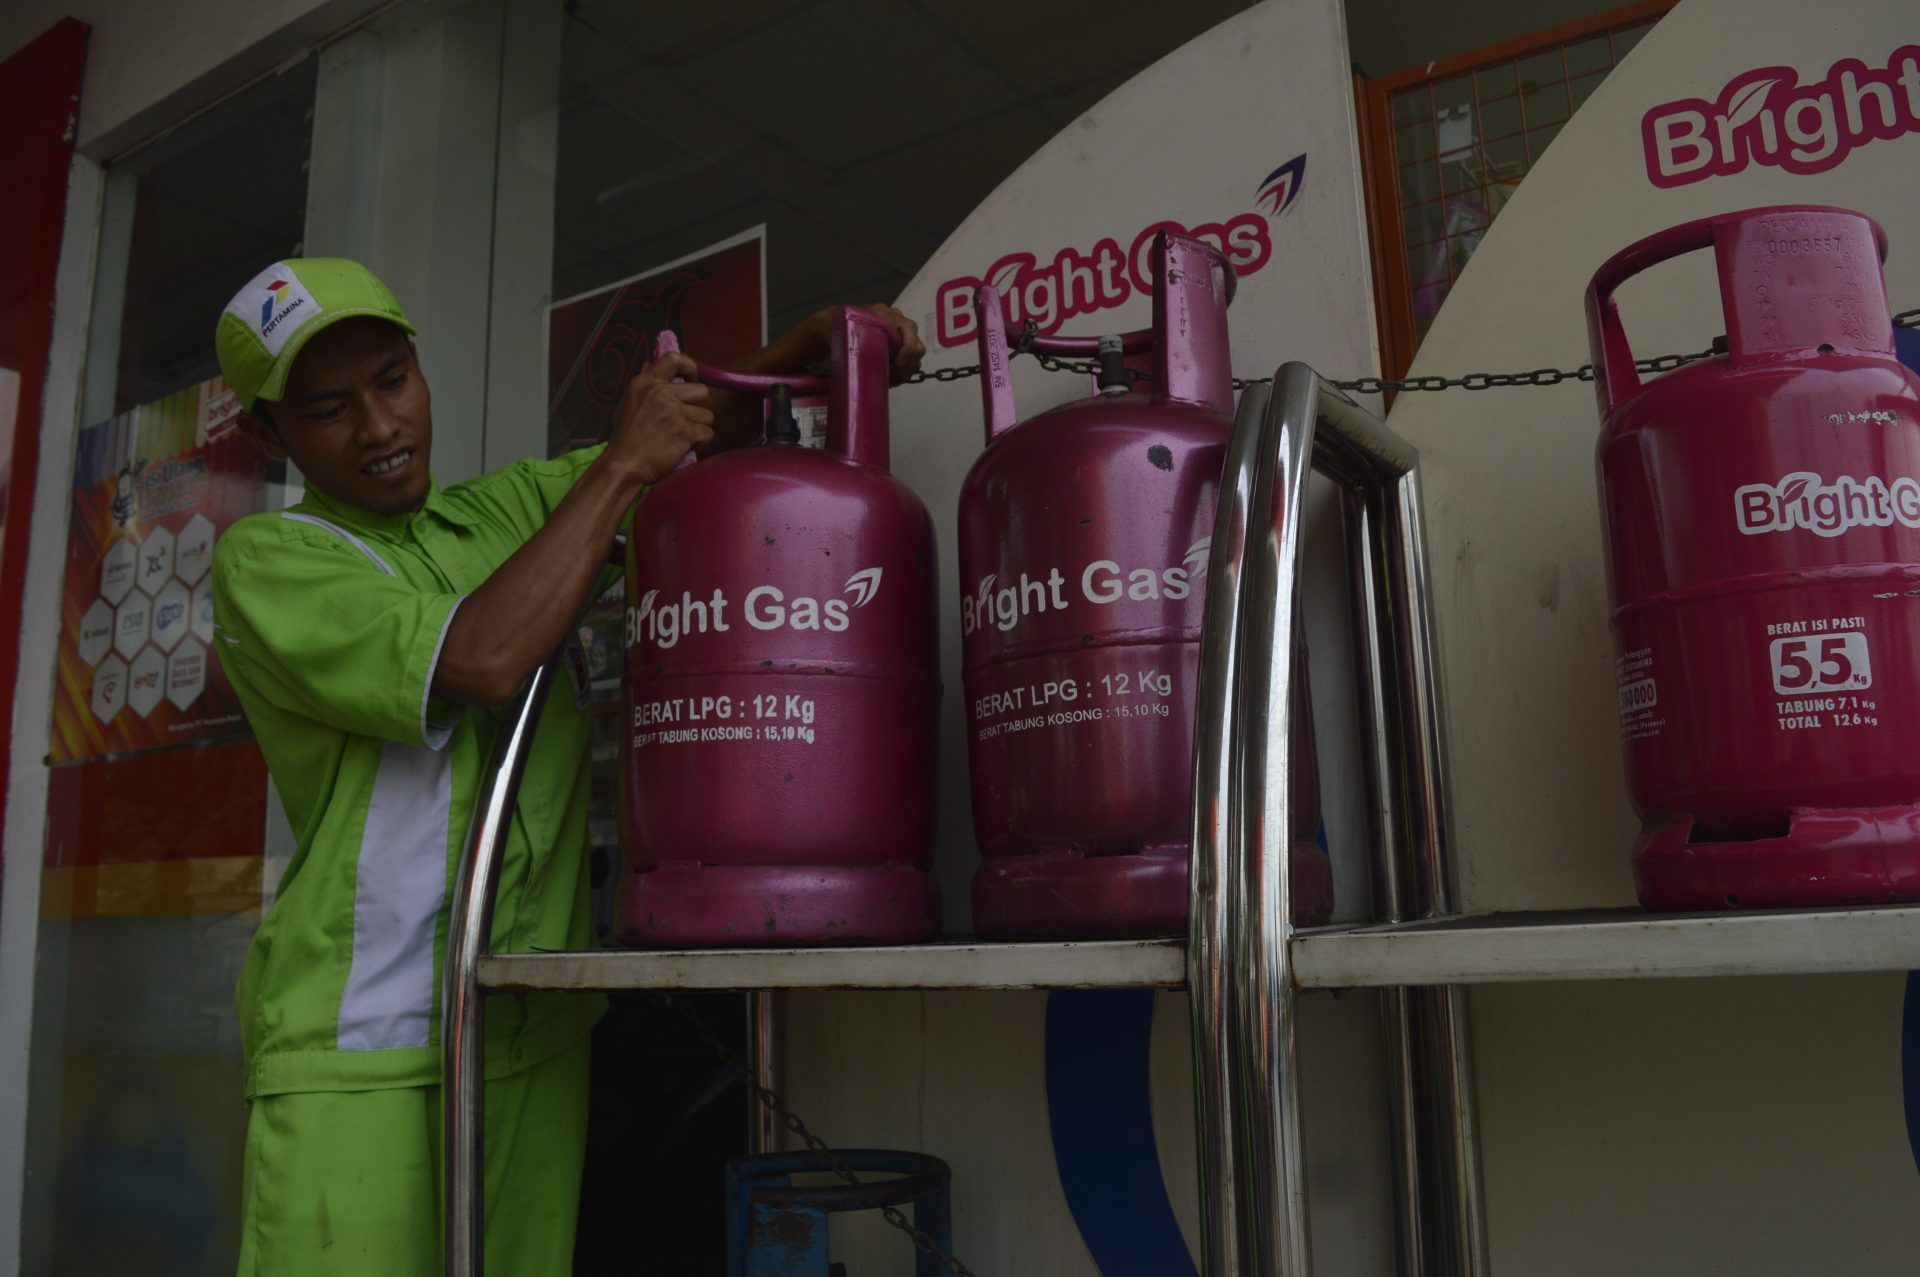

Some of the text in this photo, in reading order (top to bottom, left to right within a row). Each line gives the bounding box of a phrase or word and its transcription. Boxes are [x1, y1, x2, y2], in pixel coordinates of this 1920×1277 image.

[1654, 57, 1920, 177] Bright
[262, 298, 304, 337] PERTAMINA
[1741, 478, 1888, 529] Bright
[624, 585, 850, 649] Bright Gas
[963, 559, 1191, 636] Bright Gas
[1767, 616, 1866, 636] BERAT ISI PASTI
[1780, 638, 1868, 687] 5,5 Kg
[634, 694, 816, 727] BERAT LPG : 12 Kg
[975, 669, 1172, 720] BERAT LPG : 12 Kg
[1777, 698, 1835, 715] TABUNG
[1862, 699, 1876, 711] Kg
[659, 727, 698, 745] TABUNG
[701, 725, 752, 742] KOSONG
[764, 725, 795, 742] 15,10
[797, 726, 815, 744] Kg
[978, 723, 1003, 741] BERAT
[1004, 716, 1045, 733] TABUNG
[1047, 708, 1103, 725] KOSONG
[1115, 704, 1149, 718] 15,10
[1151, 703, 1169, 717] Kg
[1778, 714, 1822, 730] TOTAL
[1864, 714, 1878, 727] Kg
